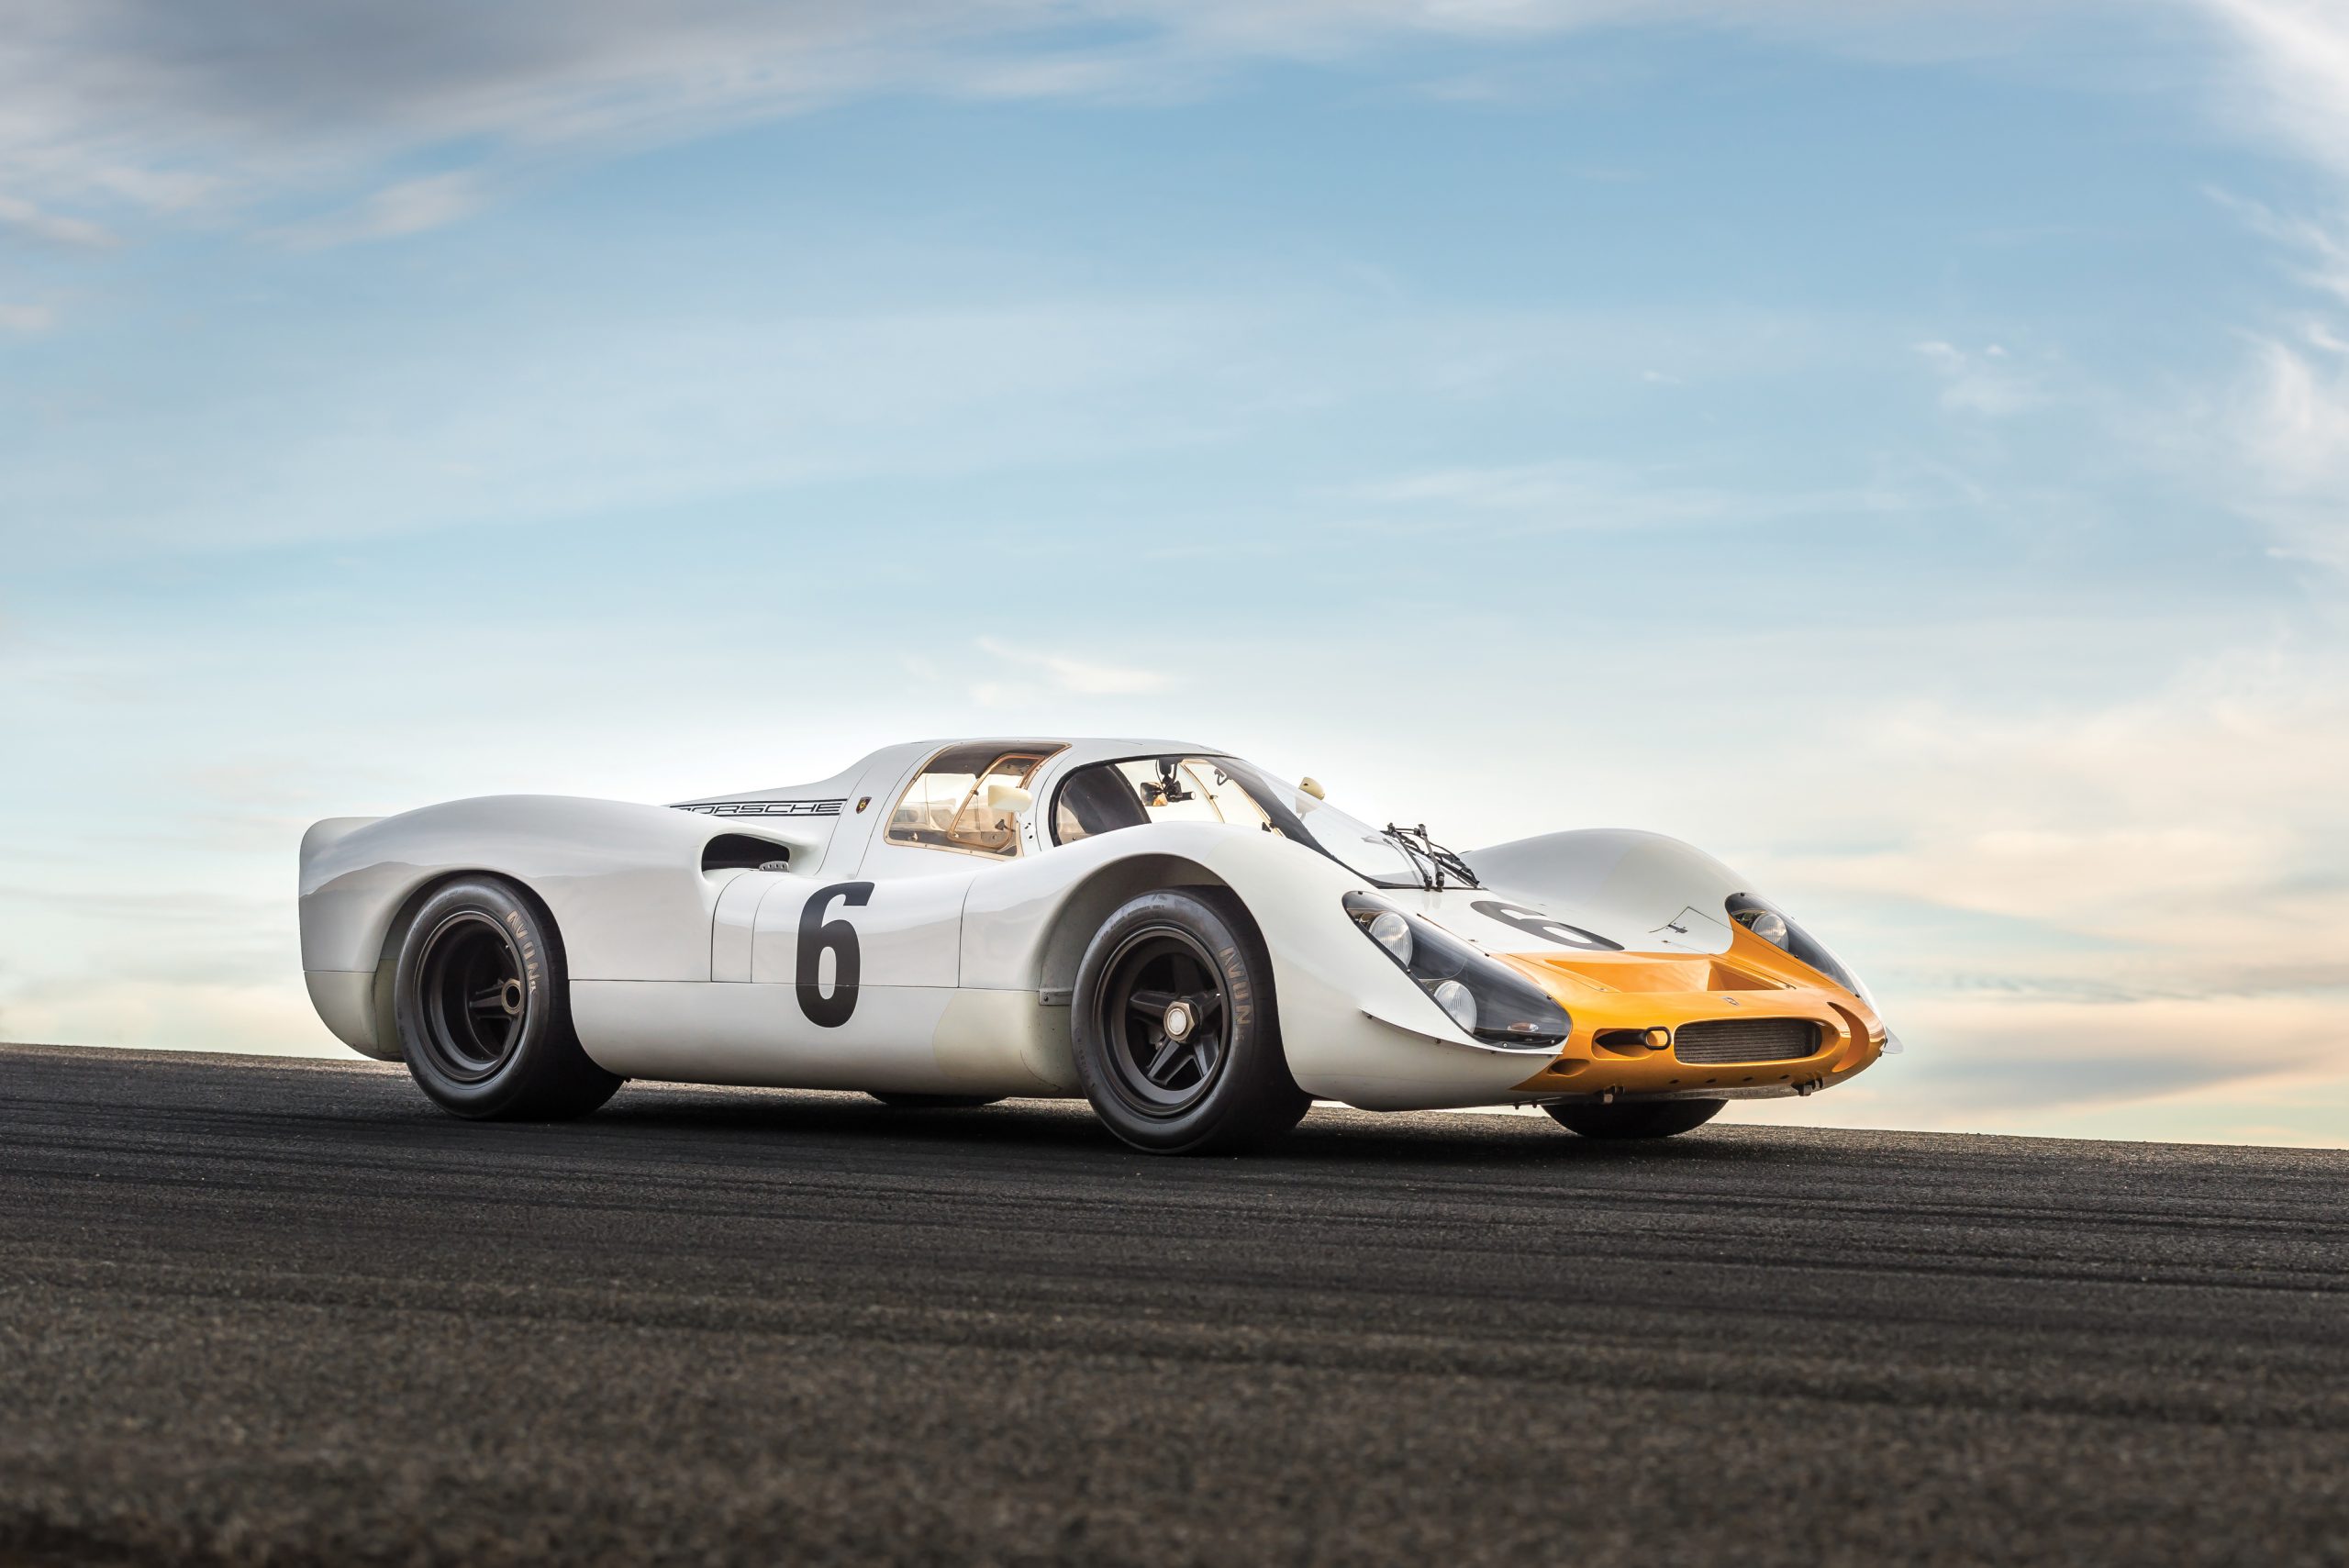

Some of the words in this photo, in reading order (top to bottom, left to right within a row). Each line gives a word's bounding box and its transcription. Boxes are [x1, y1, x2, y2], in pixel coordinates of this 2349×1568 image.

[506, 909, 540, 981] AVON
[796, 881, 875, 1029] 6
[1470, 900, 1625, 951] 6
[1218, 947, 1252, 1025] AVON
